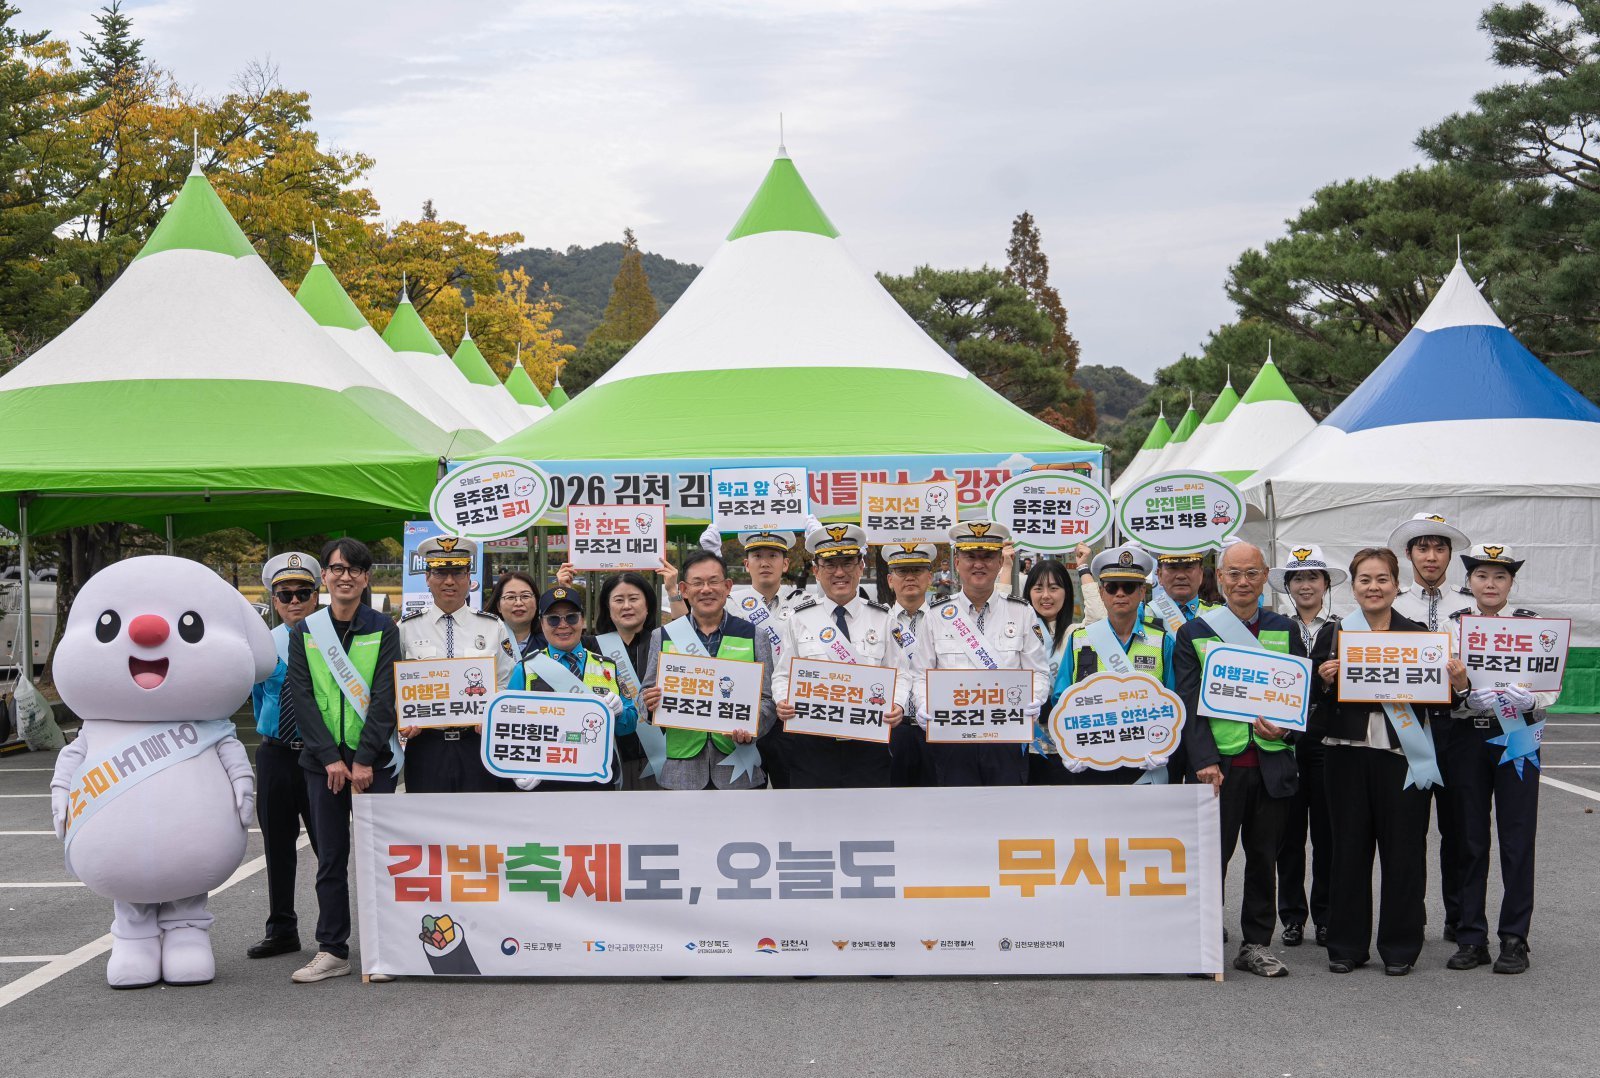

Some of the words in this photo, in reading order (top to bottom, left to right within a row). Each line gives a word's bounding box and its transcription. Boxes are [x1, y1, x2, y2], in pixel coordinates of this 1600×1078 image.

[460, 476, 482, 486] 오늘도
[493, 469, 516, 480] 무사고
[454, 484, 510, 508] 음주운전
[550, 475, 606, 508] 026
[614, 474, 670, 507] 김천
[679, 475, 710, 507] 김
[718, 482, 748, 497] 학교
[754, 480, 770, 496] 앞
[1023, 486, 1046, 494] 오늘도
[1058, 486, 1081, 496] 무사고
[1154, 485, 1174, 493] 오늘도
[1184, 482, 1204, 490] 무사고
[718, 500, 765, 516] 무조건
[770, 498, 802, 514] 주의
[868, 496, 920, 513] 정지선
[1013, 499, 1072, 515] 음주운전
[1146, 494, 1206, 513] 안전벨트
[456, 505, 499, 527] 무조건
[502, 499, 530, 519] 금지
[868, 515, 914, 530] 무조건
[920, 514, 952, 530] 준수
[1131, 515, 1174, 532] 무조건
[1178, 512, 1208, 528] 착용
[574, 518, 590, 536] 한
[596, 518, 630, 535] 잔도
[1012, 519, 1056, 534] 무조건
[1061, 520, 1088, 534] 금지
[574, 538, 621, 554] 무조건
[626, 538, 658, 554] 대리
[1467, 631, 1488, 652] 한
[1493, 633, 1533, 653] 잔도
[1346, 646, 1418, 664] 졸음운전
[1466, 654, 1522, 673] 무조건
[1527, 656, 1560, 673] 대리
[400, 671, 420, 680] 오늘도
[428, 670, 450, 680] 무사고
[666, 664, 686, 674] 오늘도
[694, 666, 716, 676] 무사고
[798, 670, 820, 680] 오늘도
[828, 672, 852, 682] 무사고
[1212, 663, 1269, 686] 여행길도
[1346, 666, 1400, 685] 무조건
[1406, 666, 1442, 684] 금지
[401, 683, 450, 700] 여행길
[663, 676, 714, 697] 운행전
[794, 681, 864, 704] 과속운전
[1209, 682, 1248, 700] 오늘도
[1263, 689, 1302, 708] 무사고
[952, 688, 1004, 706] 장거리
[1075, 694, 1102, 707] 오늘도
[1118, 688, 1148, 702] 무사고
[402, 701, 446, 719] 오늘도
[500, 704, 526, 715] 오늘도
[539, 706, 566, 716] 무사고
[661, 696, 712, 716] 무조건
[718, 702, 751, 721] 점검
[794, 702, 844, 723] 무조건
[850, 707, 883, 728] 금지
[934, 708, 984, 726] 무조건
[990, 708, 1024, 726] 휴식
[1064, 712, 1118, 730] 대중교통
[1121, 705, 1174, 724] 안전수칙
[1392, 702, 1412, 728] 사고
[495, 722, 559, 742] 무단횡단
[1076, 728, 1115, 746] 무조건
[1118, 726, 1146, 742] 실천
[494, 744, 541, 764] 무조건
[546, 746, 578, 764] 금지
[387, 842, 702, 904] 김밥축제도,
[716, 841, 896, 899] 오늘도
[998, 837, 1186, 898] 무사고
[524, 942, 562, 951] 국토교통부
[582, 940, 606, 952] TS
[608, 943, 663, 952] 한국교통안전공단
[698, 940, 730, 948] 경상북도
[851, 940, 896, 948] 경상북도경찰청
[1014, 941, 1065, 949] 김천모범운전자회
